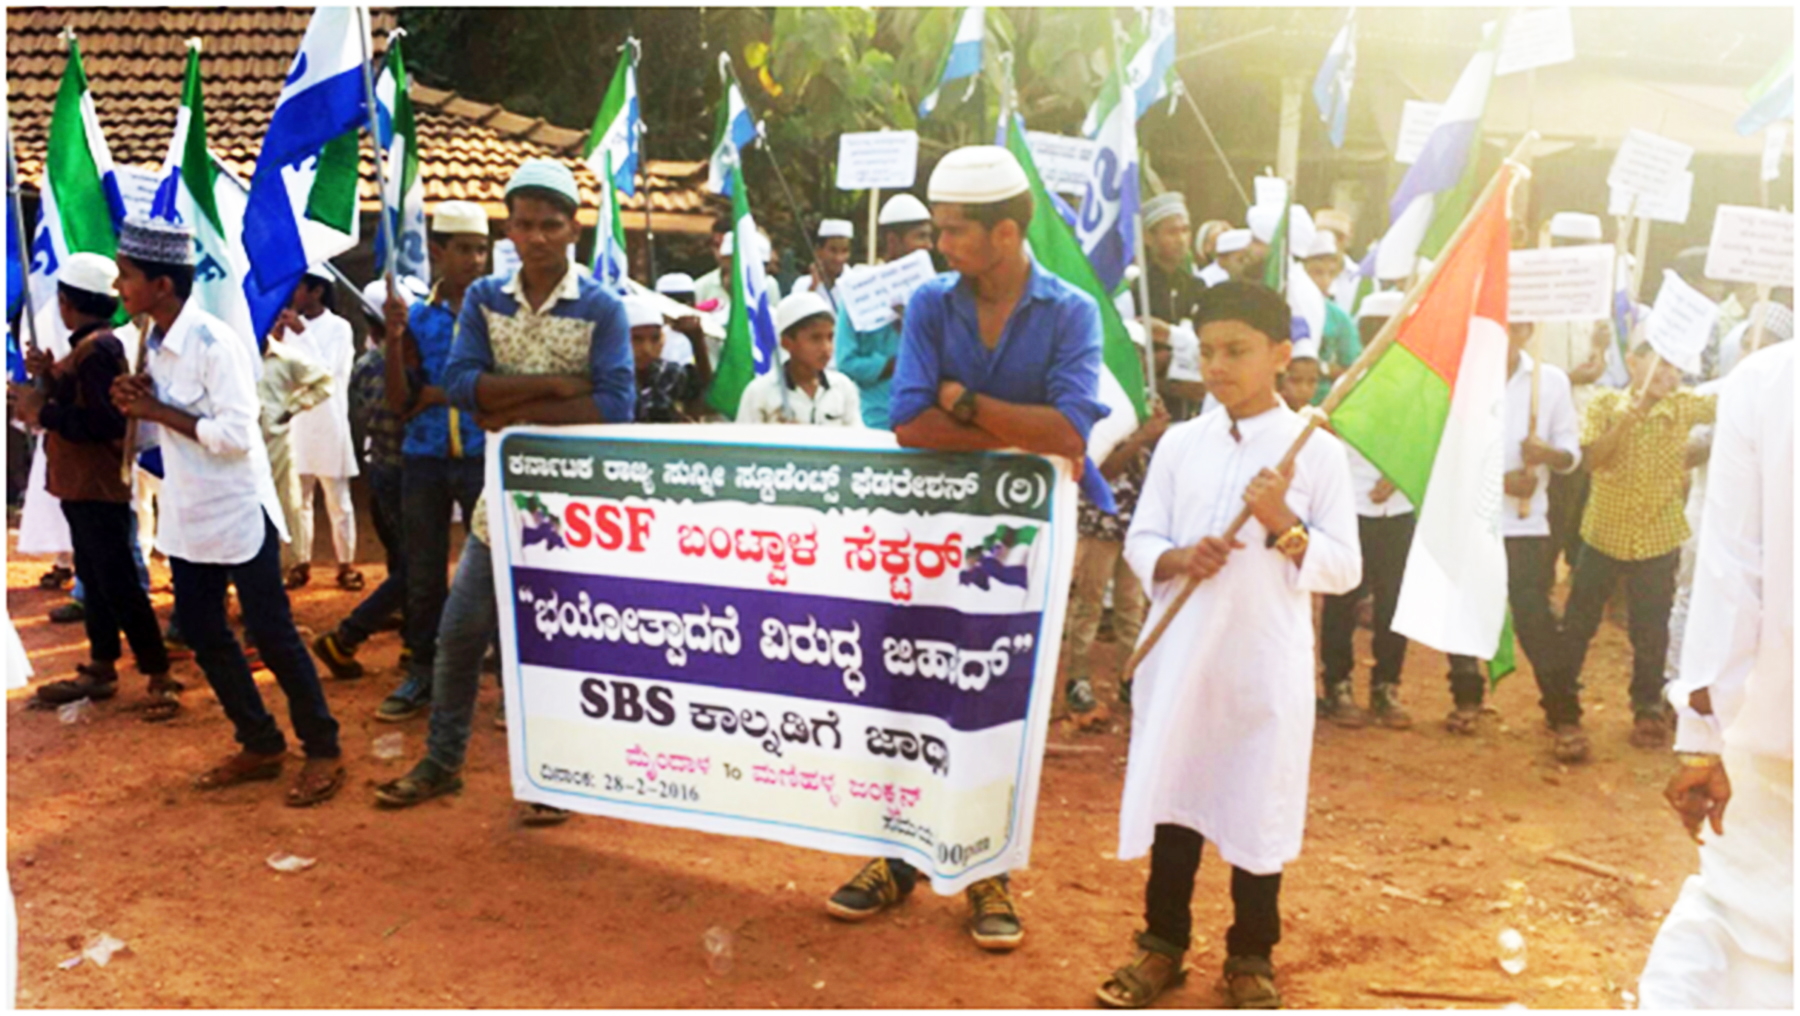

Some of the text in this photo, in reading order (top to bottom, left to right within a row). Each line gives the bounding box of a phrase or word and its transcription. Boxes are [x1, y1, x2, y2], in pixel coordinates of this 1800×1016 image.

[508, 454, 595, 480] ಕರ್ನಾಟಕ
[602, 460, 656, 495] ರಾಜ್ಯ
[995, 471, 1047, 509] (ರಿ)
[563, 501, 964, 602] SSF ಬಂಟ್ವಾಳ ಸೆಕ್ಟರ್
[759, 613, 867, 697] ವಿರುದ್ಧ
[579, 677, 676, 727] SBS
[688, 702, 842, 758] ಕಾಲ್ನಡಿಗೆ
[603, 772, 701, 802] 28-2-2016
